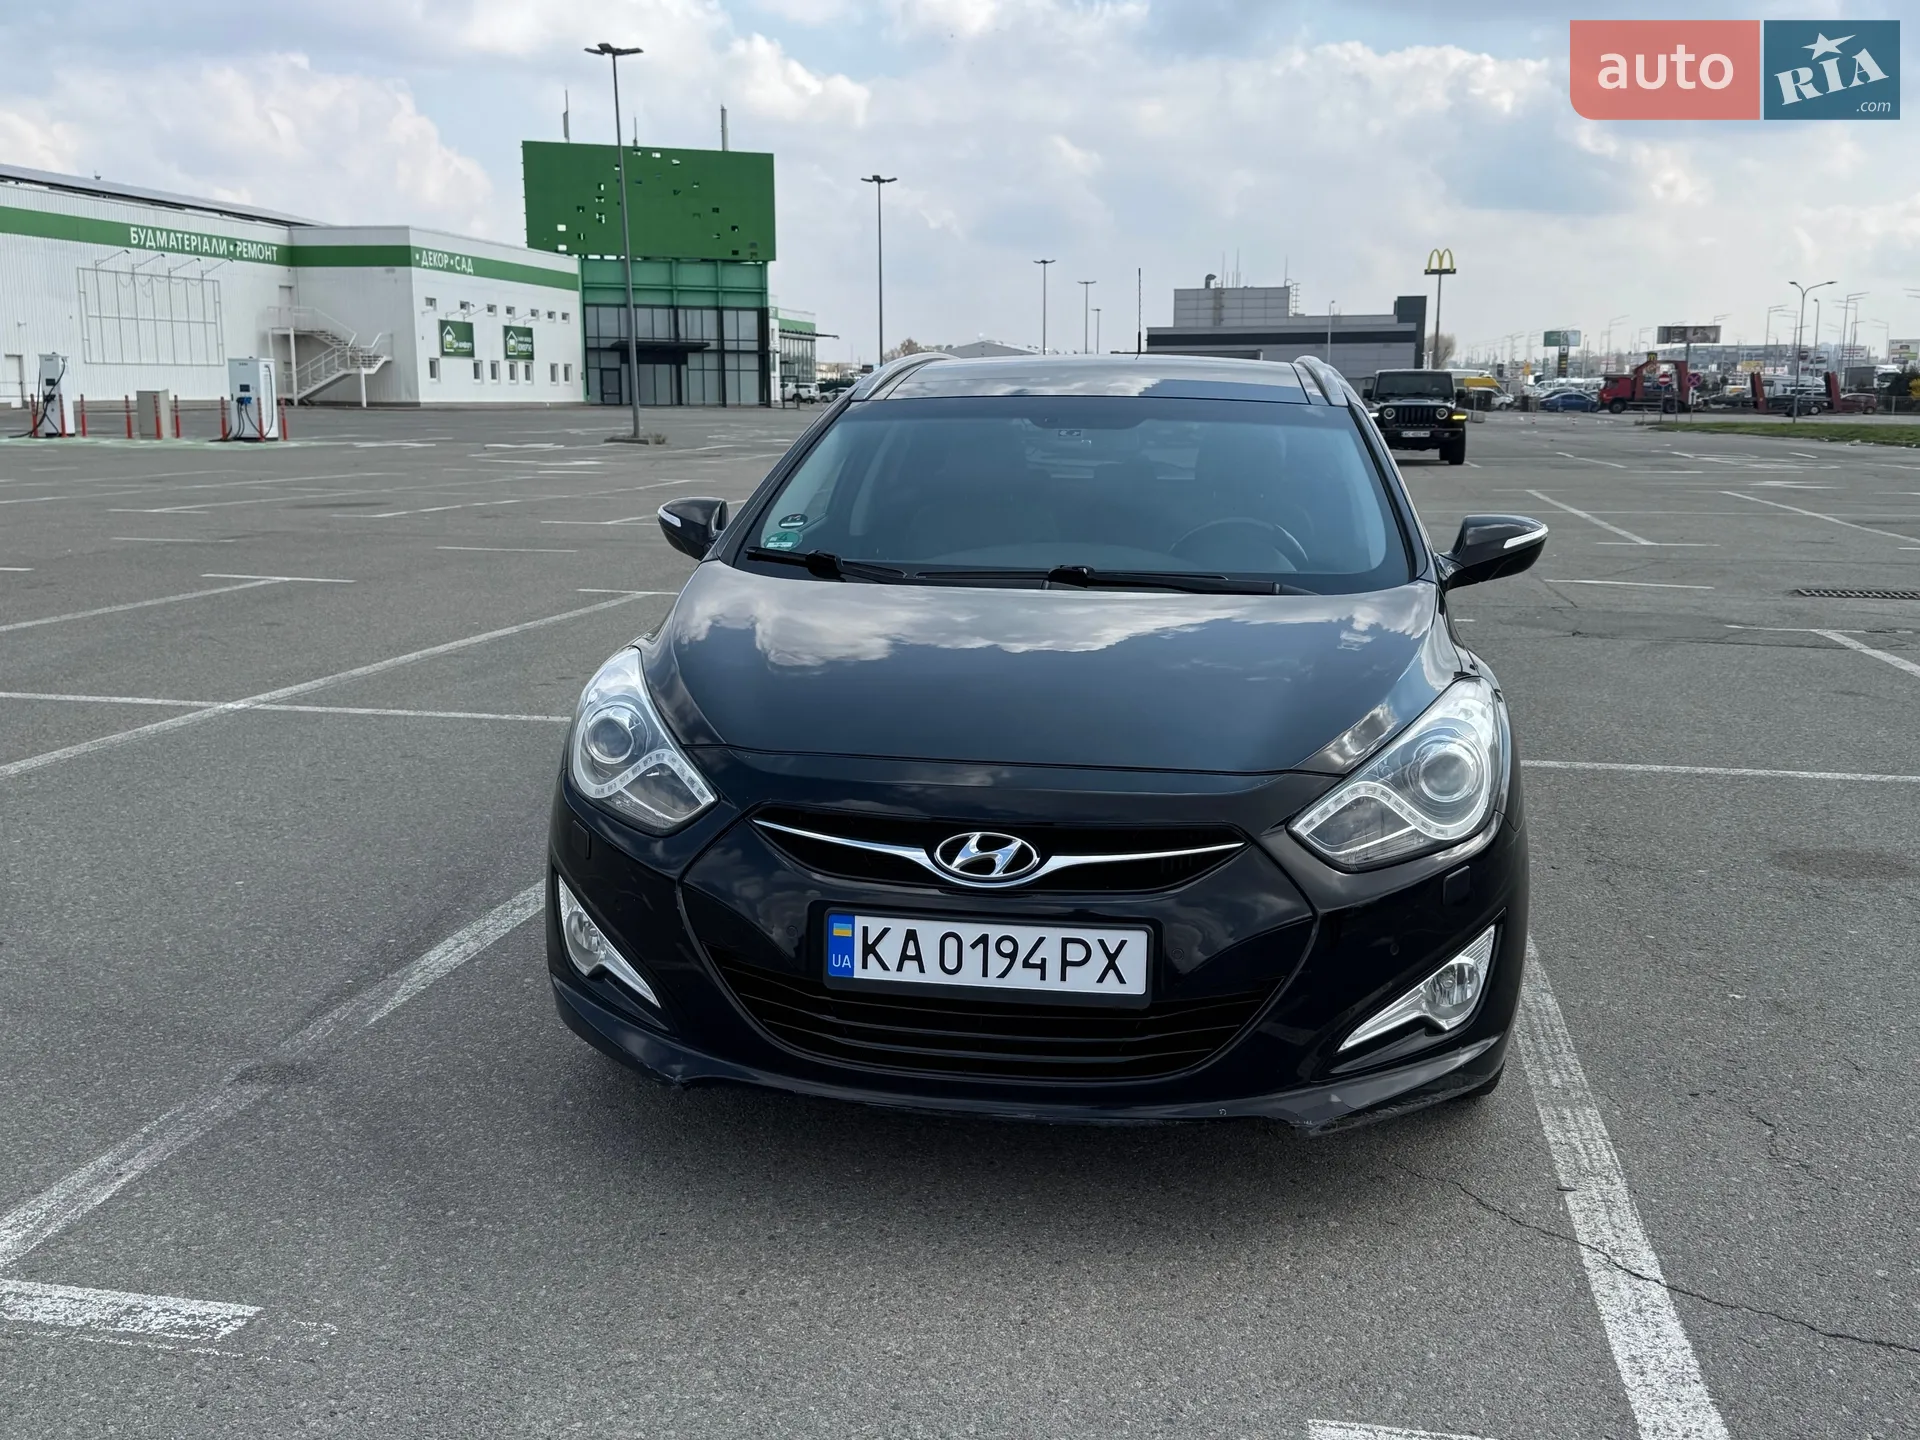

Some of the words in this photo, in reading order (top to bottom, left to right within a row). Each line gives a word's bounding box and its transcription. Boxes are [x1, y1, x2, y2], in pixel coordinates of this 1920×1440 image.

[130, 226, 228, 256] БУДМАТЕРІАЛИ
[236, 240, 278, 262] РЕМОНТ
[421, 249, 449, 269] ДЕКОР
[454, 255, 474, 275] САД
[832, 953, 852, 969] UA
[861, 925, 926, 974] KA
[938, 930, 1047, 981] 0194
[1059, 936, 1128, 985] PX
